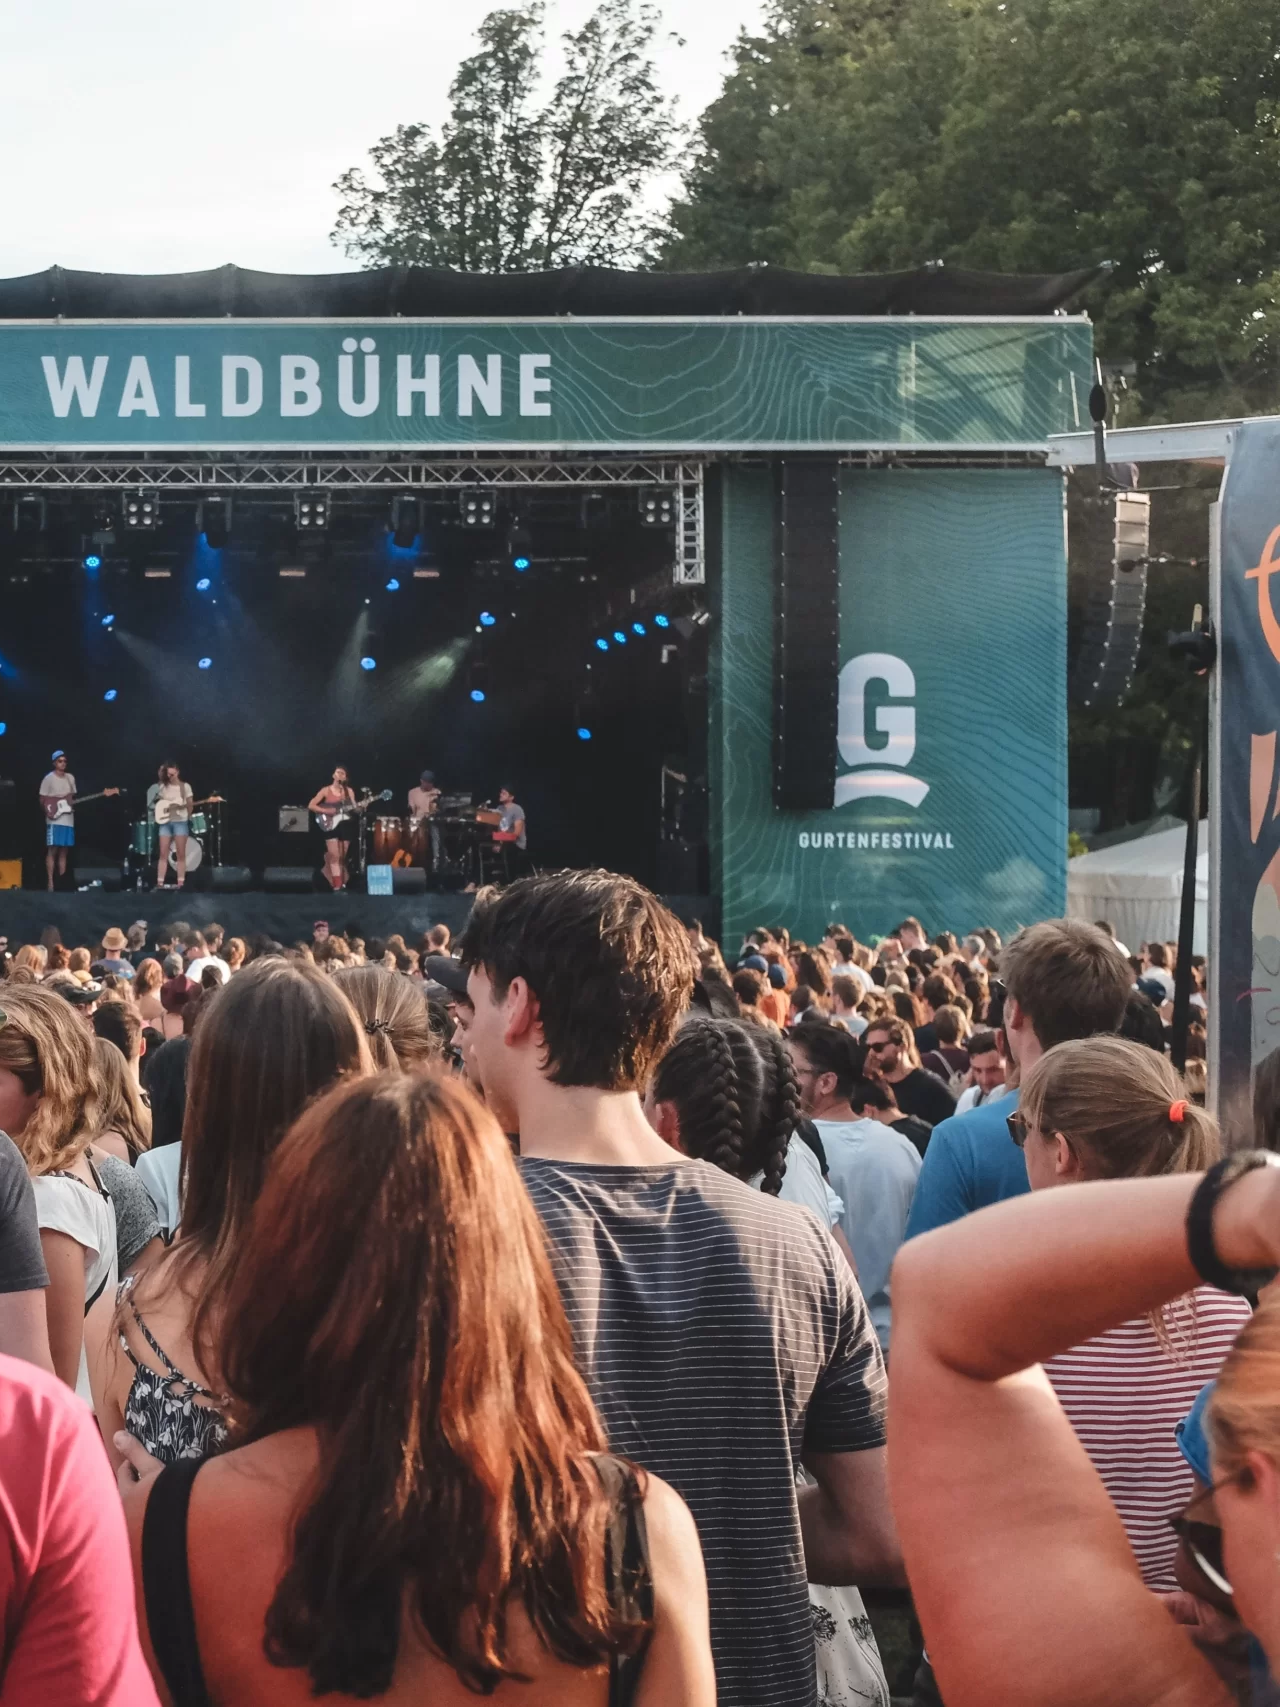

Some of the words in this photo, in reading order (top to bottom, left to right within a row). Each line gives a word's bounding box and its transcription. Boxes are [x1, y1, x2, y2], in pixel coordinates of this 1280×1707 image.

[41, 337, 552, 418] WALDBÜHNE
[837, 652, 917, 768] G
[798, 831, 955, 849] GURTENFESTIVAL
